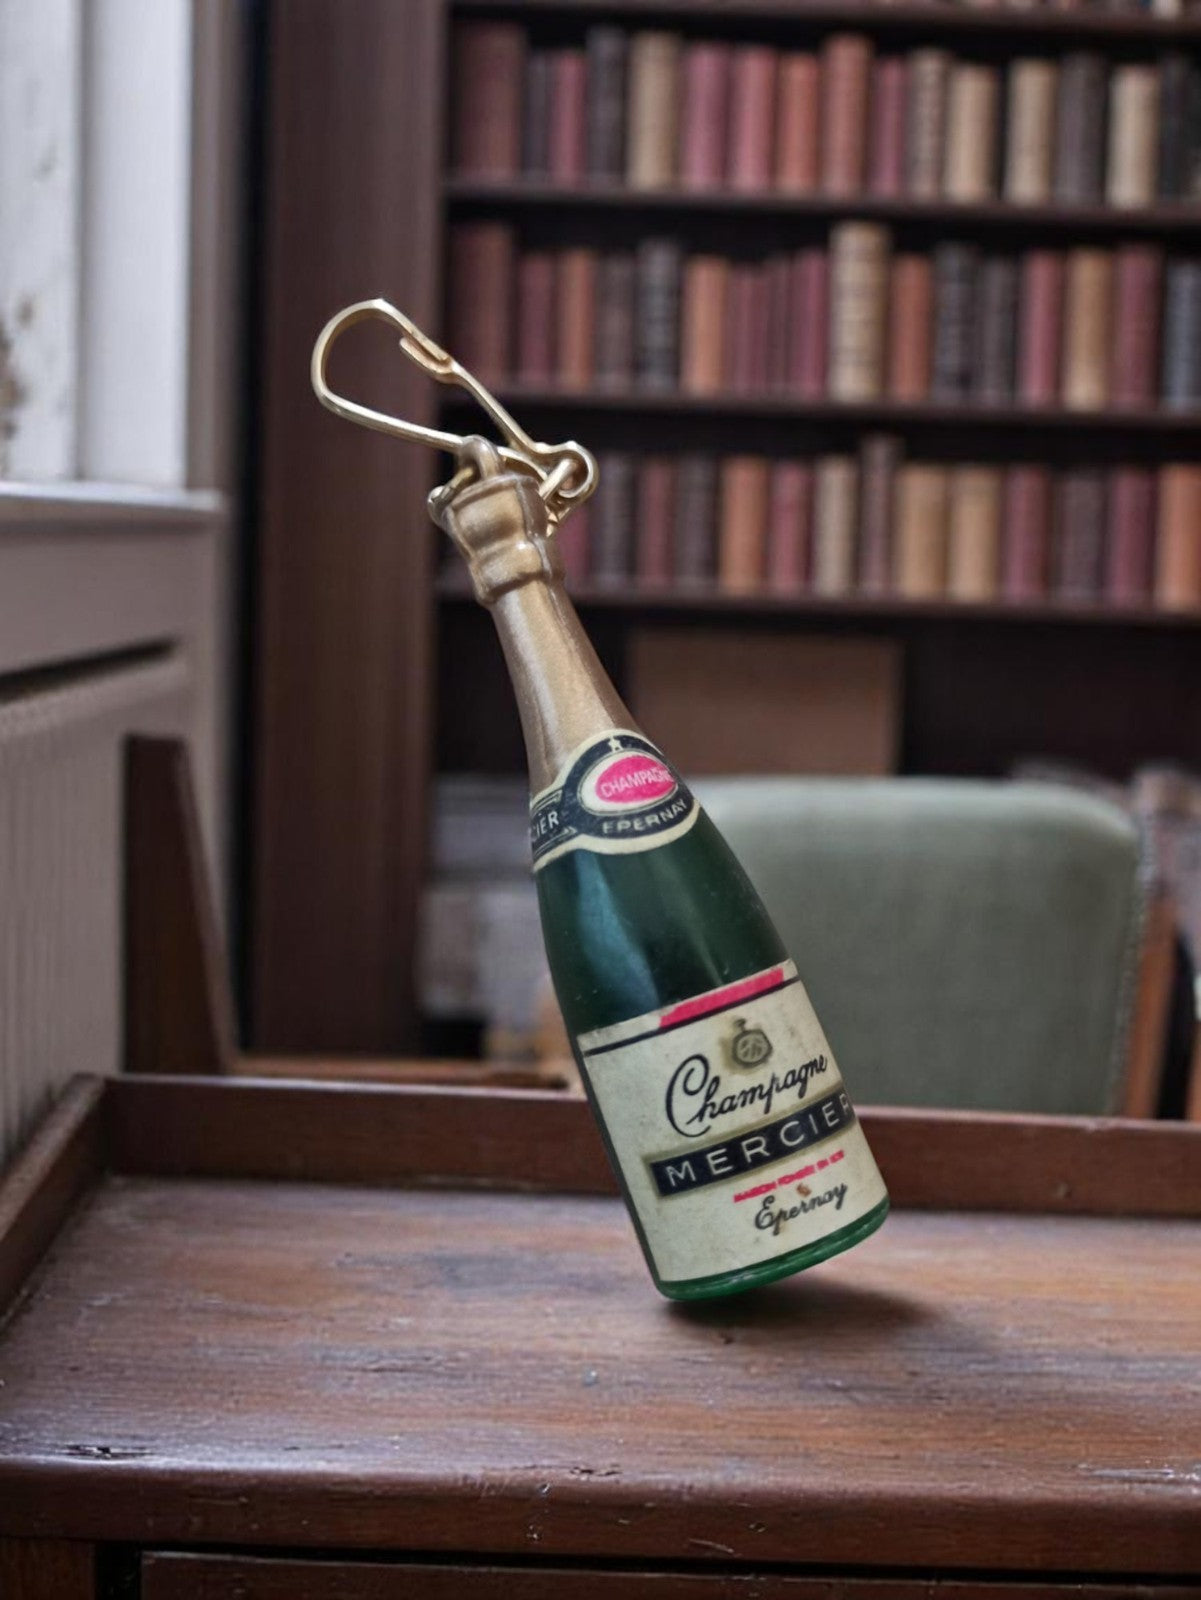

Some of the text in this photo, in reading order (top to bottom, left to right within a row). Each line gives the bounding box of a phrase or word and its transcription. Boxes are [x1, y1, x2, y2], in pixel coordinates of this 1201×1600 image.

[602, 798, 688, 835] EPERNAY
[665, 1053, 828, 1138] Champagne
[754, 1183, 849, 1236] Epernay
